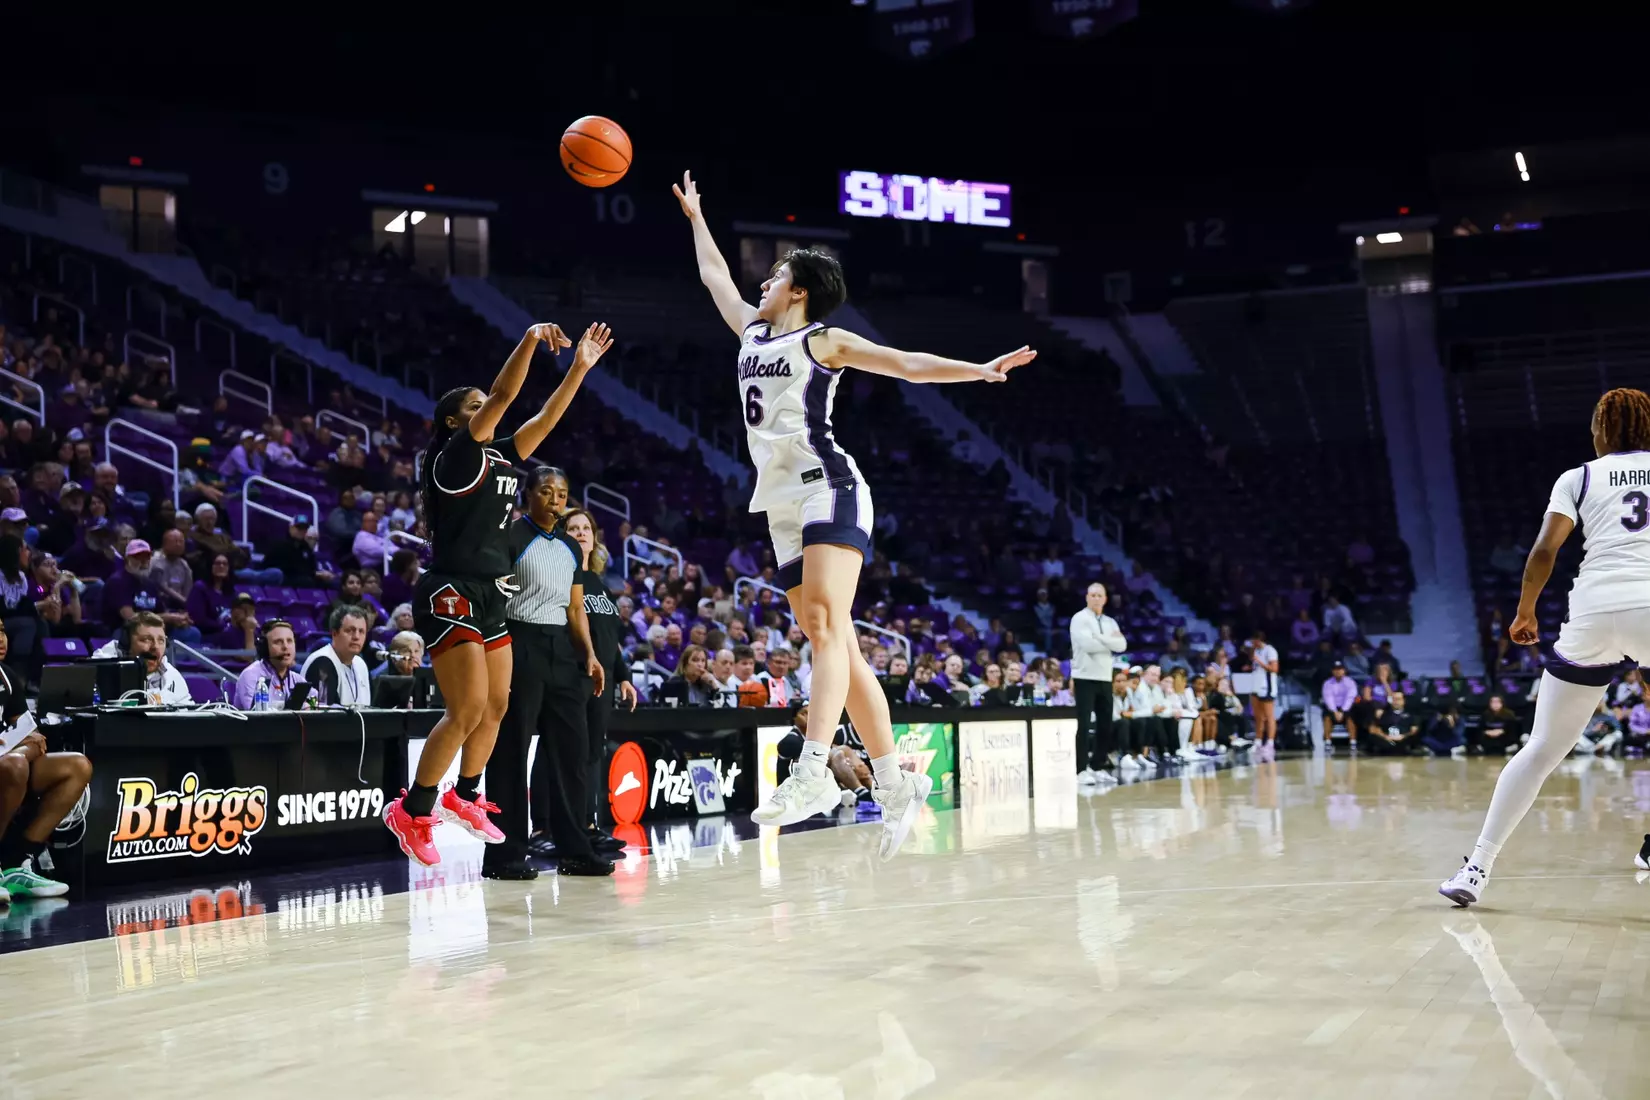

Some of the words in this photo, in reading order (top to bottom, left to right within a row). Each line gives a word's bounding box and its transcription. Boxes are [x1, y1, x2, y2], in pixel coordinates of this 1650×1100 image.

[262, 161, 290, 195] 9
[592, 193, 635, 224] 10
[845, 170, 1011, 227] SOME
[1183, 217, 1228, 249] 12
[745, 384, 765, 427] 6
[1620, 491, 1650, 533] 3
[650, 758, 693, 810] Pizz
[111, 773, 267, 855] Briggs
[277, 791, 336, 826] SINCE
[338, 787, 385, 820] 1979
[111, 836, 188, 858] AUTO.COM
